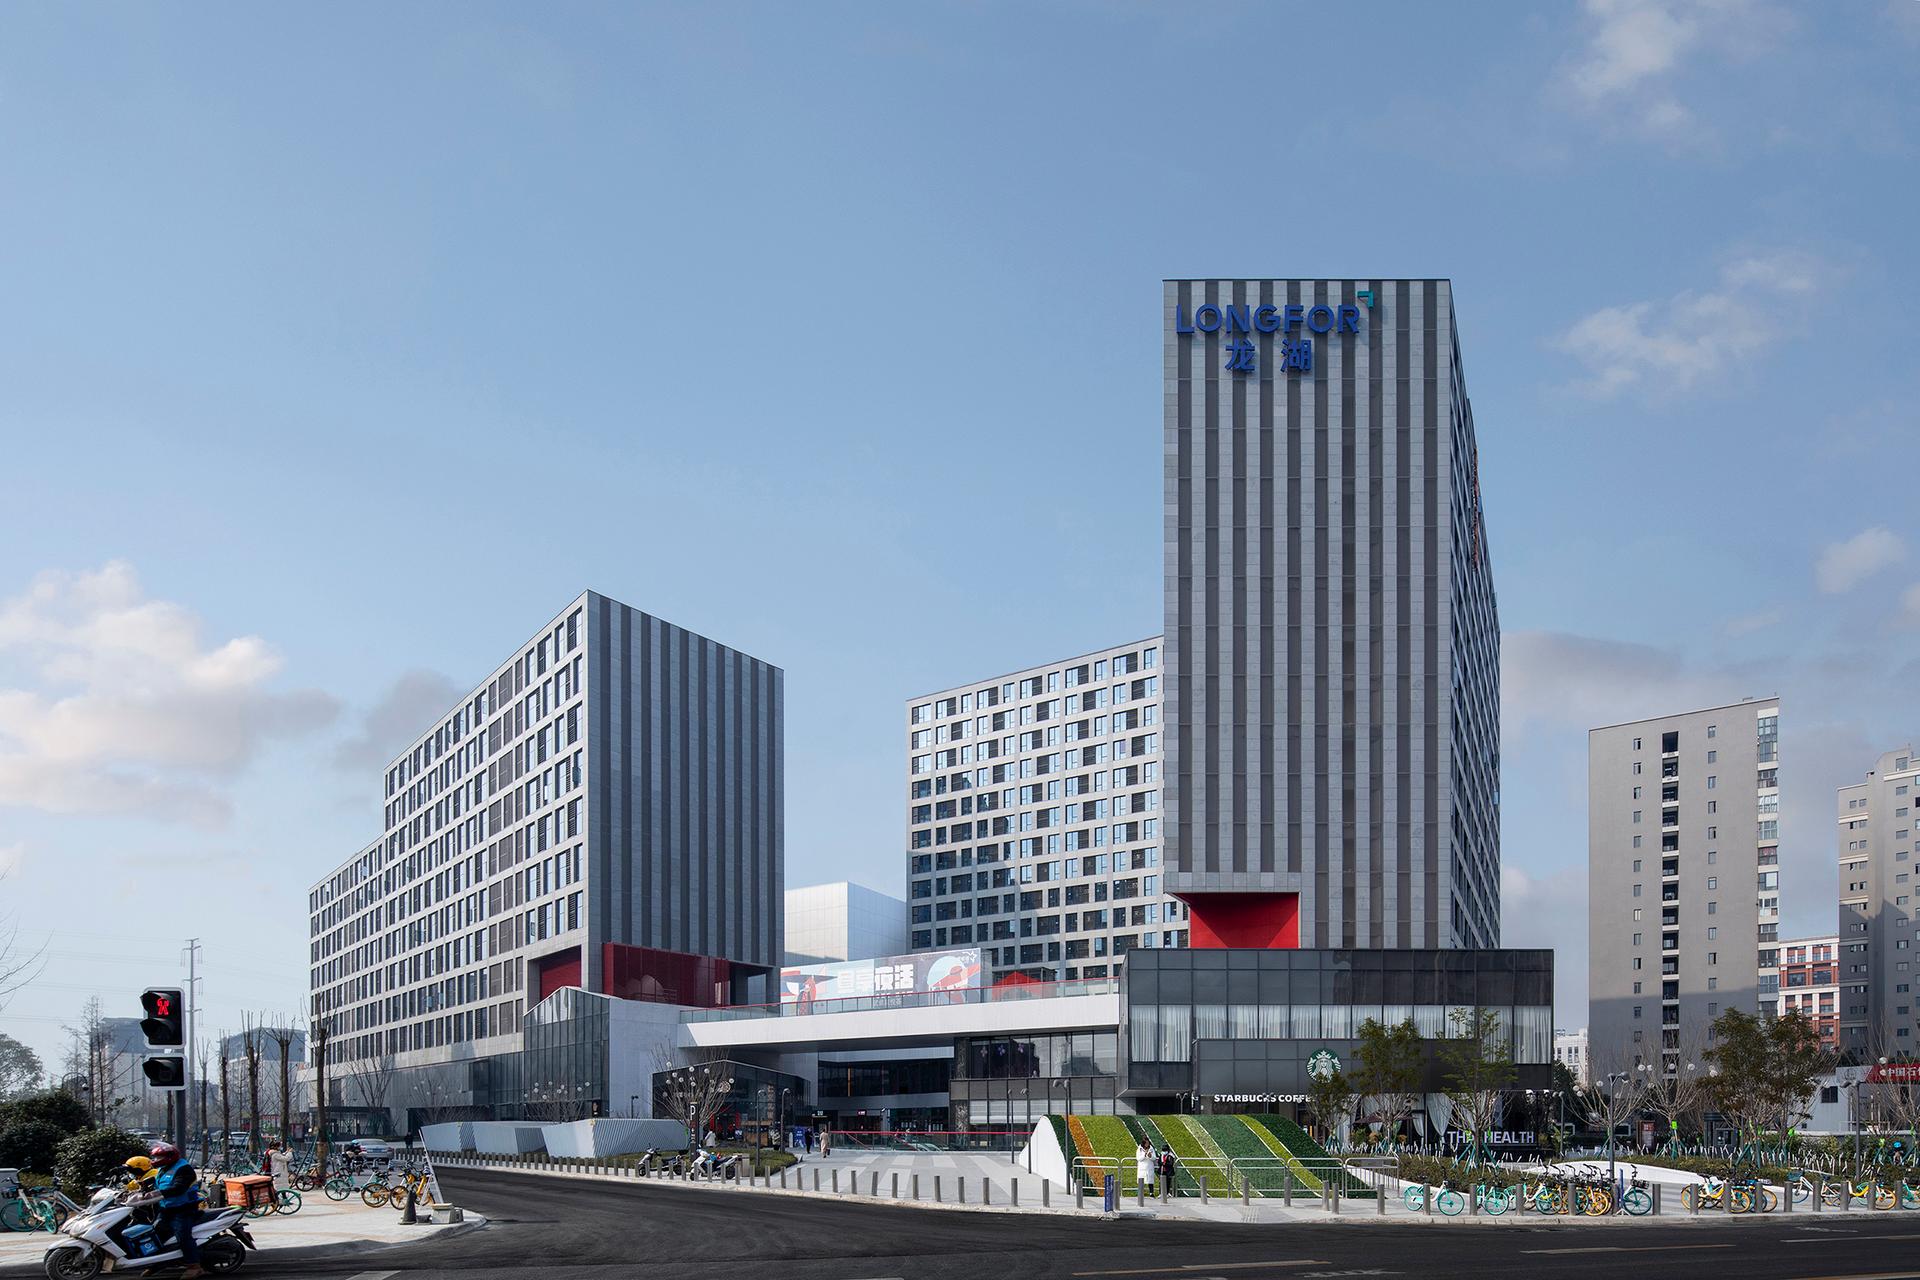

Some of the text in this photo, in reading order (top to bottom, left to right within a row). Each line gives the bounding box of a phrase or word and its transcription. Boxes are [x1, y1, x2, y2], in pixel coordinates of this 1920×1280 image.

[1176, 303, 1361, 334] LONGFOR
[1225, 338, 1312, 373] 龙湖
[1214, 1094, 1315, 1103] STARBUCKS COFFE
[690, 1105, 696, 1120] P
[1484, 1131, 1534, 1144] HEALTH
